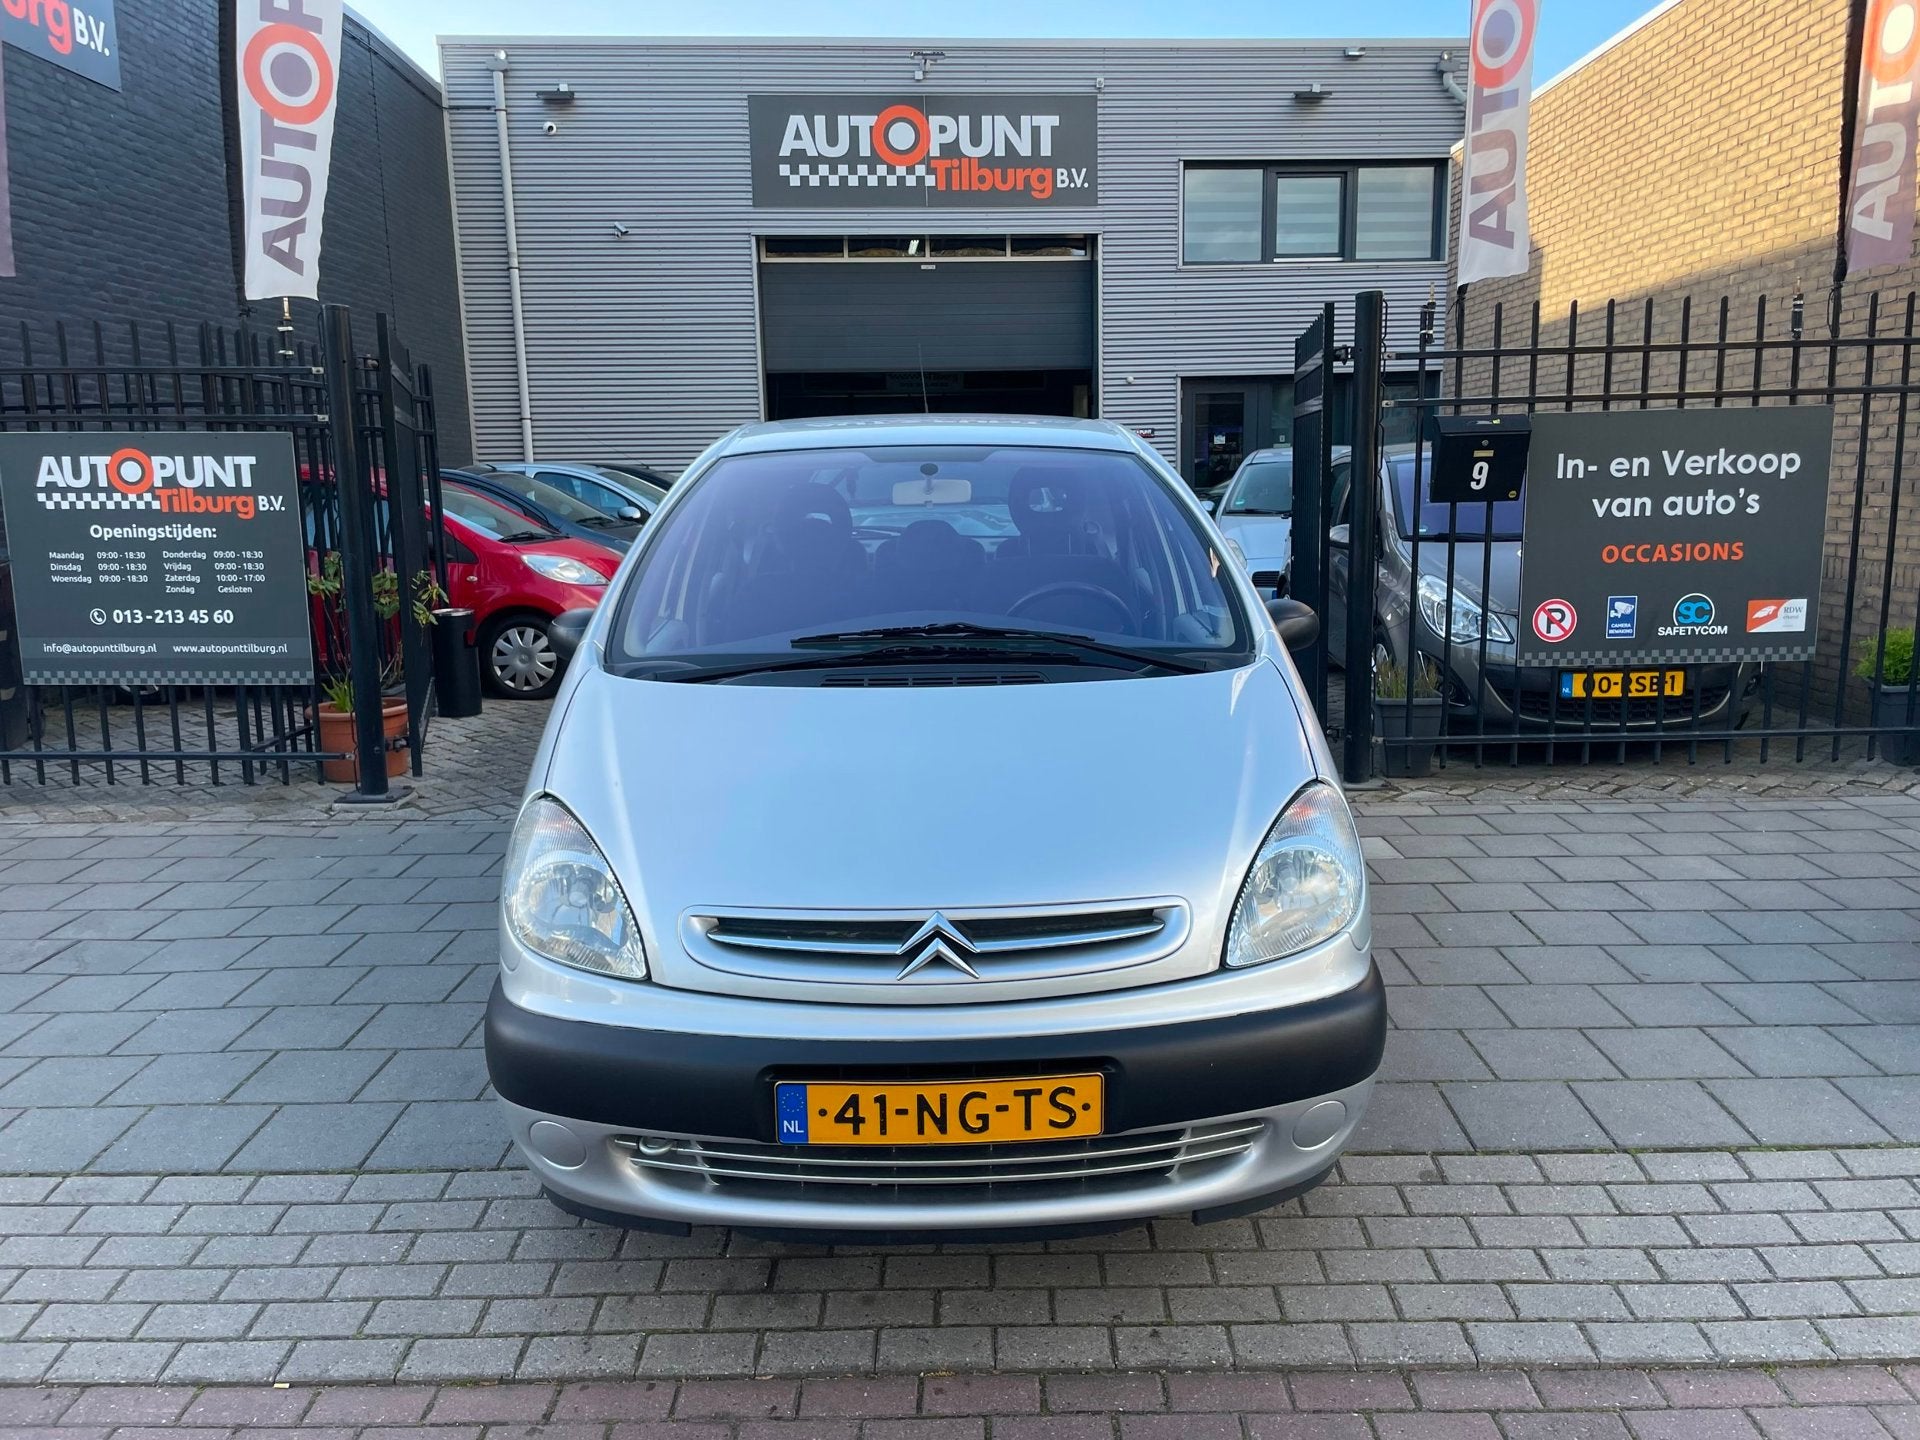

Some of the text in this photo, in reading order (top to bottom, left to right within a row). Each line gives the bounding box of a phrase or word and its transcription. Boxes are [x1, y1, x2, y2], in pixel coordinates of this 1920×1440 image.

[73, 8, 110, 57] B.V.
[778, 104, 1060, 167] AUTOPUNT
[930, 158, 1089, 199] Tilburg B.V.
[36, 448, 257, 495] AUTOPUNT
[1556, 448, 1801, 480] In- en Verkoop
[1470, 461, 1489, 490] 9
[155, 488, 286, 520] Tilburg B.V.
[1592, 488, 1760, 517] van auto's
[89, 524, 217, 541] Openingstijden:
[49, 551, 85, 561] Maandag
[96, 551, 118, 559] 09:00
[124, 551, 146, 559] 18:30
[162, 550, 207, 560] Donderdag
[213, 551, 235, 559] 09:00
[241, 551, 263, 559] 18:30
[1601, 542, 1744, 564] OCCASIONS
[50, 563, 82, 572] Dinsdag
[98, 563, 119, 571] 09:00
[126, 563, 147, 571] 18:30
[163, 562, 192, 571] Vrijdag
[214, 562, 236, 570] 09:00
[243, 562, 265, 570] 18:30
[51, 575, 92, 584] Woensdag
[99, 575, 121, 583] 09:00
[127, 575, 148, 583] 18:30
[164, 574, 201, 583] Zaterdag
[216, 574, 238, 582] 10:00
[244, 574, 266, 582] 17:00
[165, 585, 253, 594] Zondag Gesloten
[188, 609, 209, 624] 45
[213, 609, 234, 624] 60
[1657, 625, 1728, 636] SAFETYCOM
[43, 643, 288, 654] info@autopunttilburg.nl www.autopunttilburg.nl
[783, 1086, 1078, 1136] NL 41-NG-TS
